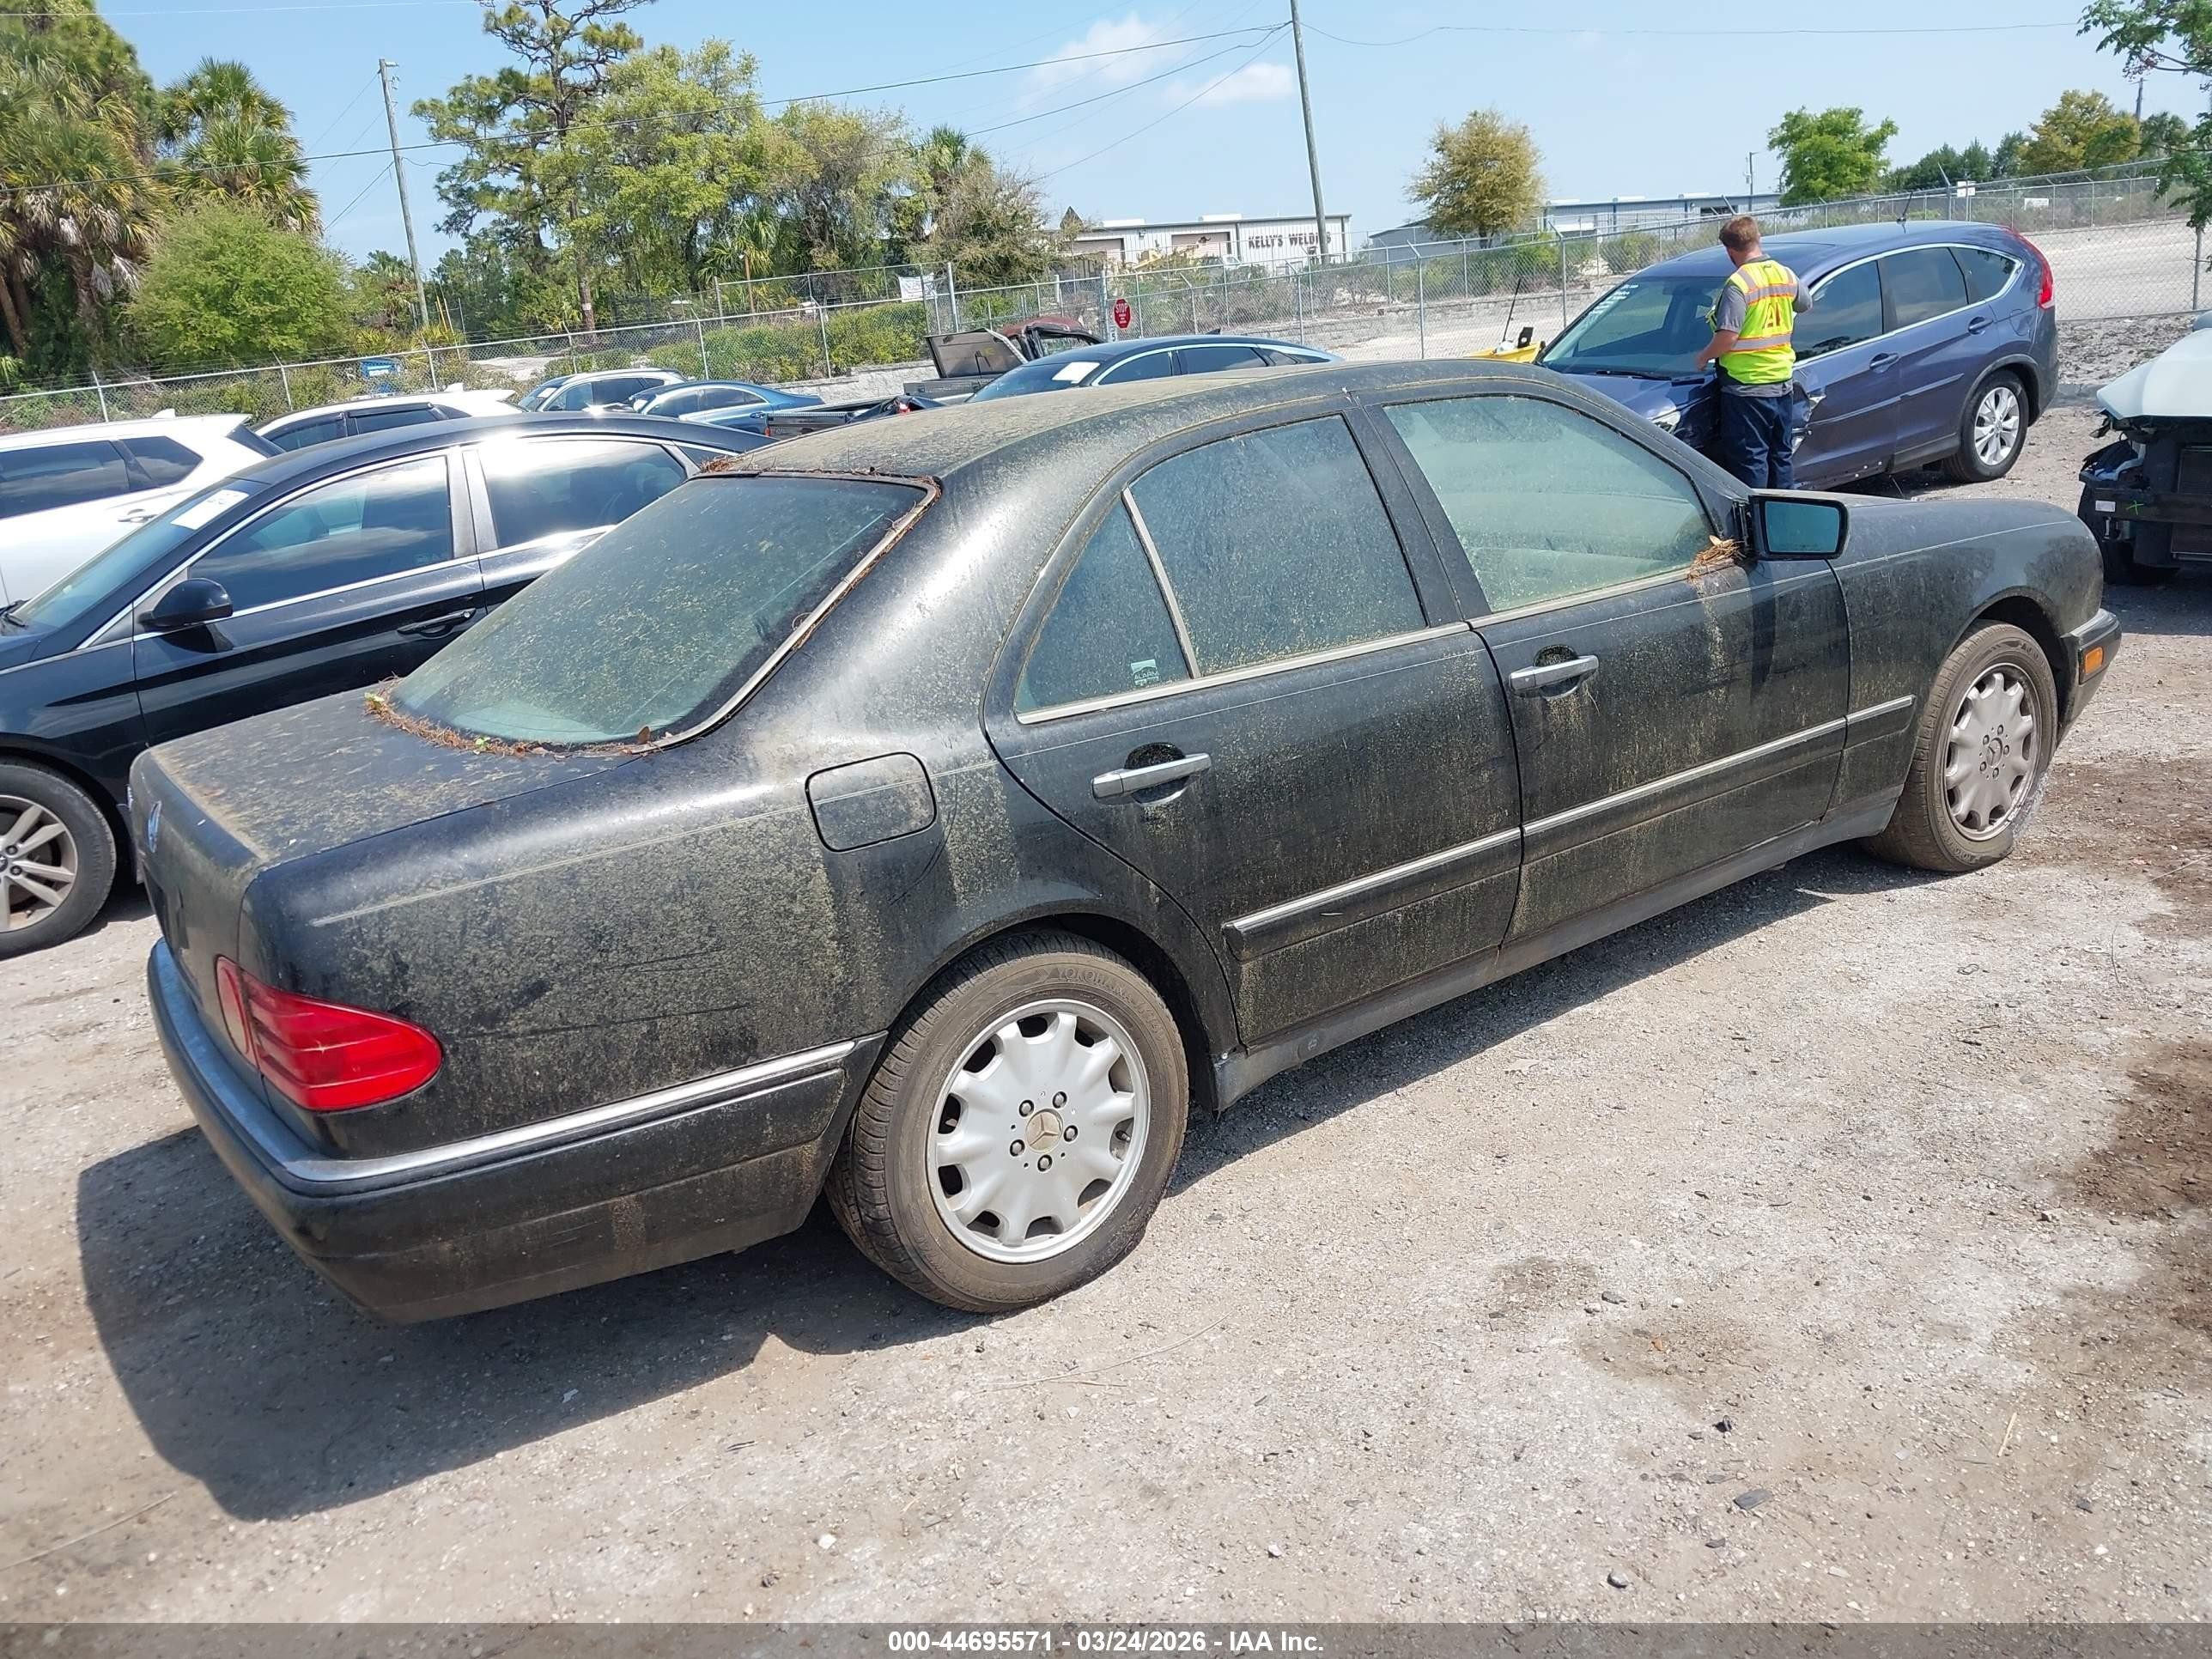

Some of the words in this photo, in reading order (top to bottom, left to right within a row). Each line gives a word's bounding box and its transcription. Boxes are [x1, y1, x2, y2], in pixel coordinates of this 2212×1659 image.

[1249, 234, 1284, 249] KELLY'S
[1288, 231, 1332, 246] WELDIG
[1115, 302, 1128, 314] STOP
